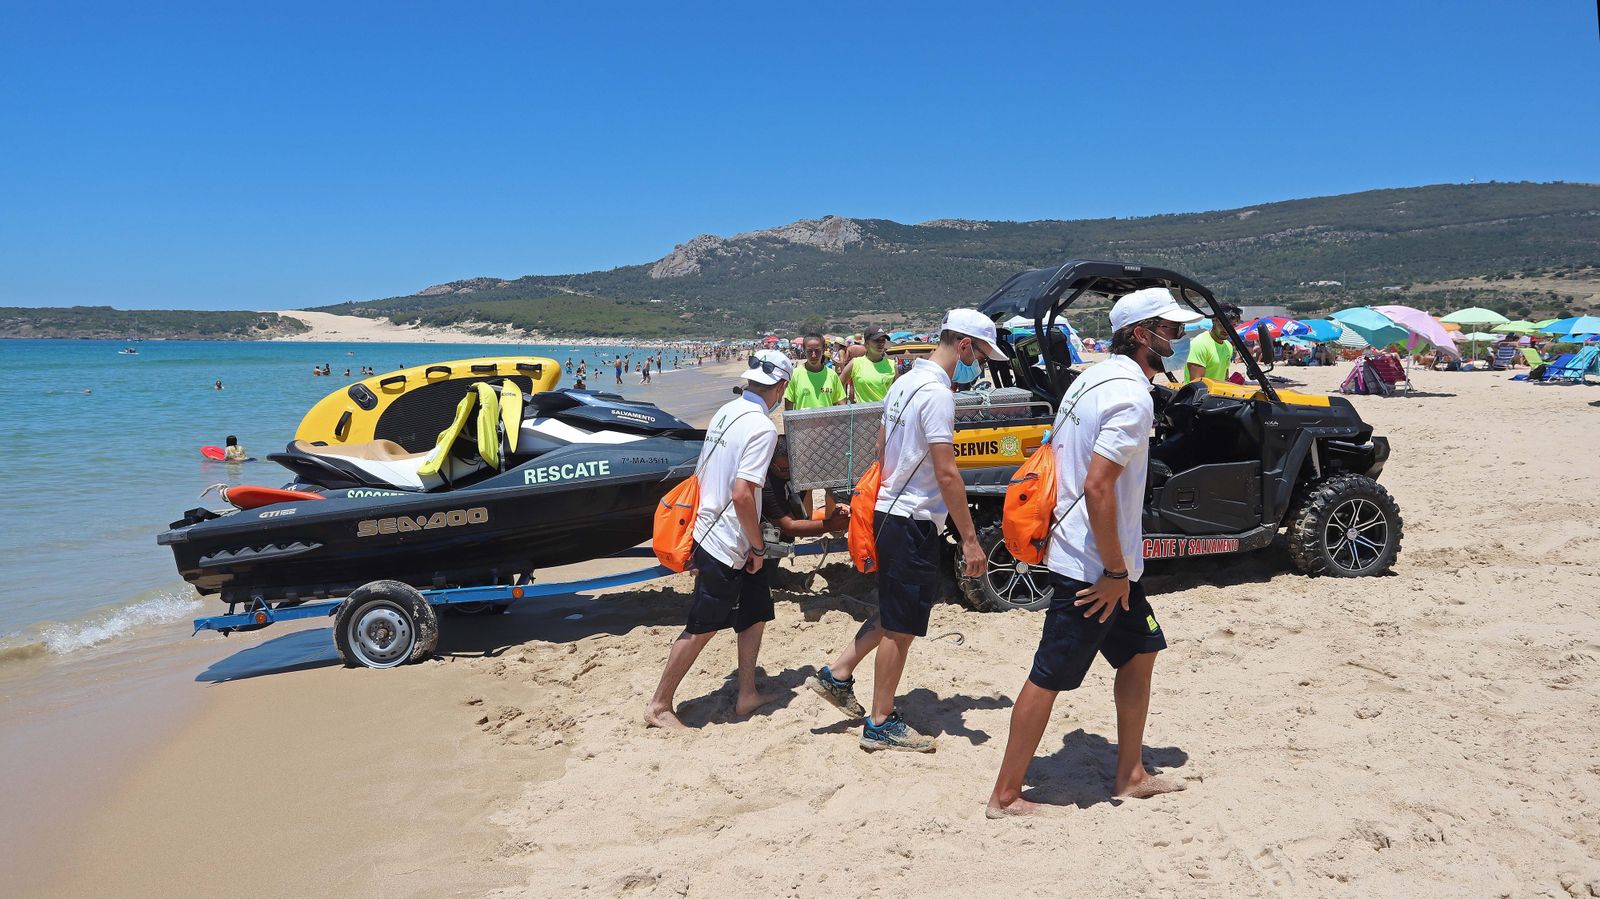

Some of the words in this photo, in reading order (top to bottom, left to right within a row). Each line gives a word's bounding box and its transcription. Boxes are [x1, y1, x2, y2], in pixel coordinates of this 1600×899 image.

[610, 409, 656, 422] SALVAMENTO
[953, 440, 998, 457] SERVIS
[523, 460, 610, 485] RESCATE
[1178, 538, 1187, 557] Y
[1188, 538, 1240, 556] SALVAMENTO
